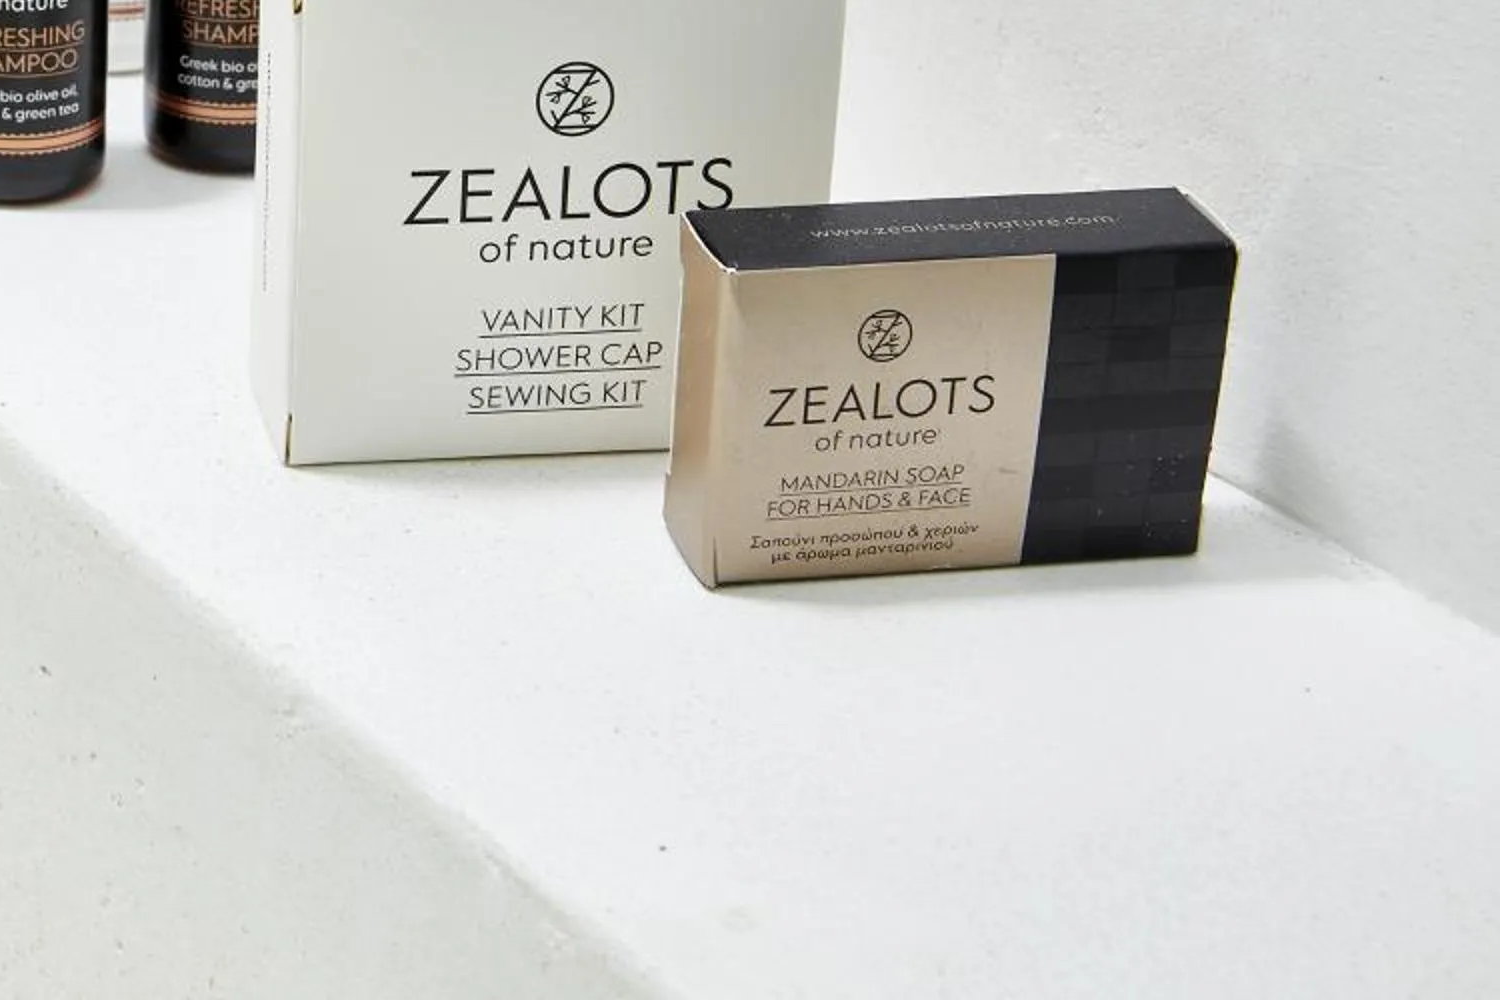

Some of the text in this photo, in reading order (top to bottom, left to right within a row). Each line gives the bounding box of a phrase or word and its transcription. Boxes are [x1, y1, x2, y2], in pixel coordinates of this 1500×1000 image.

[180, 55, 219, 72] Greek
[221, 60, 245, 73] bio
[0, 89, 23, 103] bio
[25, 88, 59, 103] olive
[178, 73, 221, 89] cotton
[222, 77, 234, 90] &
[1, 107, 13, 120] &
[14, 106, 57, 123] green
[59, 102, 80, 116] tea
[403, 157, 734, 225] ZEALOTS
[810, 214, 1116, 239] www.zealotsofnature.com
[479, 233, 654, 263] of nature
[481, 303, 645, 331] VANITY KIT
[456, 341, 663, 371] SHOWER CAP
[468, 380, 647, 409] SEWING KIT
[763, 374, 996, 428] ZEALOTS
[815, 428, 938, 451] of nature
[780, 463, 965, 492] MANDARIN SOAP
[766, 487, 973, 517] FOR HANDS & FACE
[750, 521, 980, 550] Σαπούνι προσώπου & χεριών
[770, 550, 792, 565] με
[795, 544, 851, 562] άρωμα
